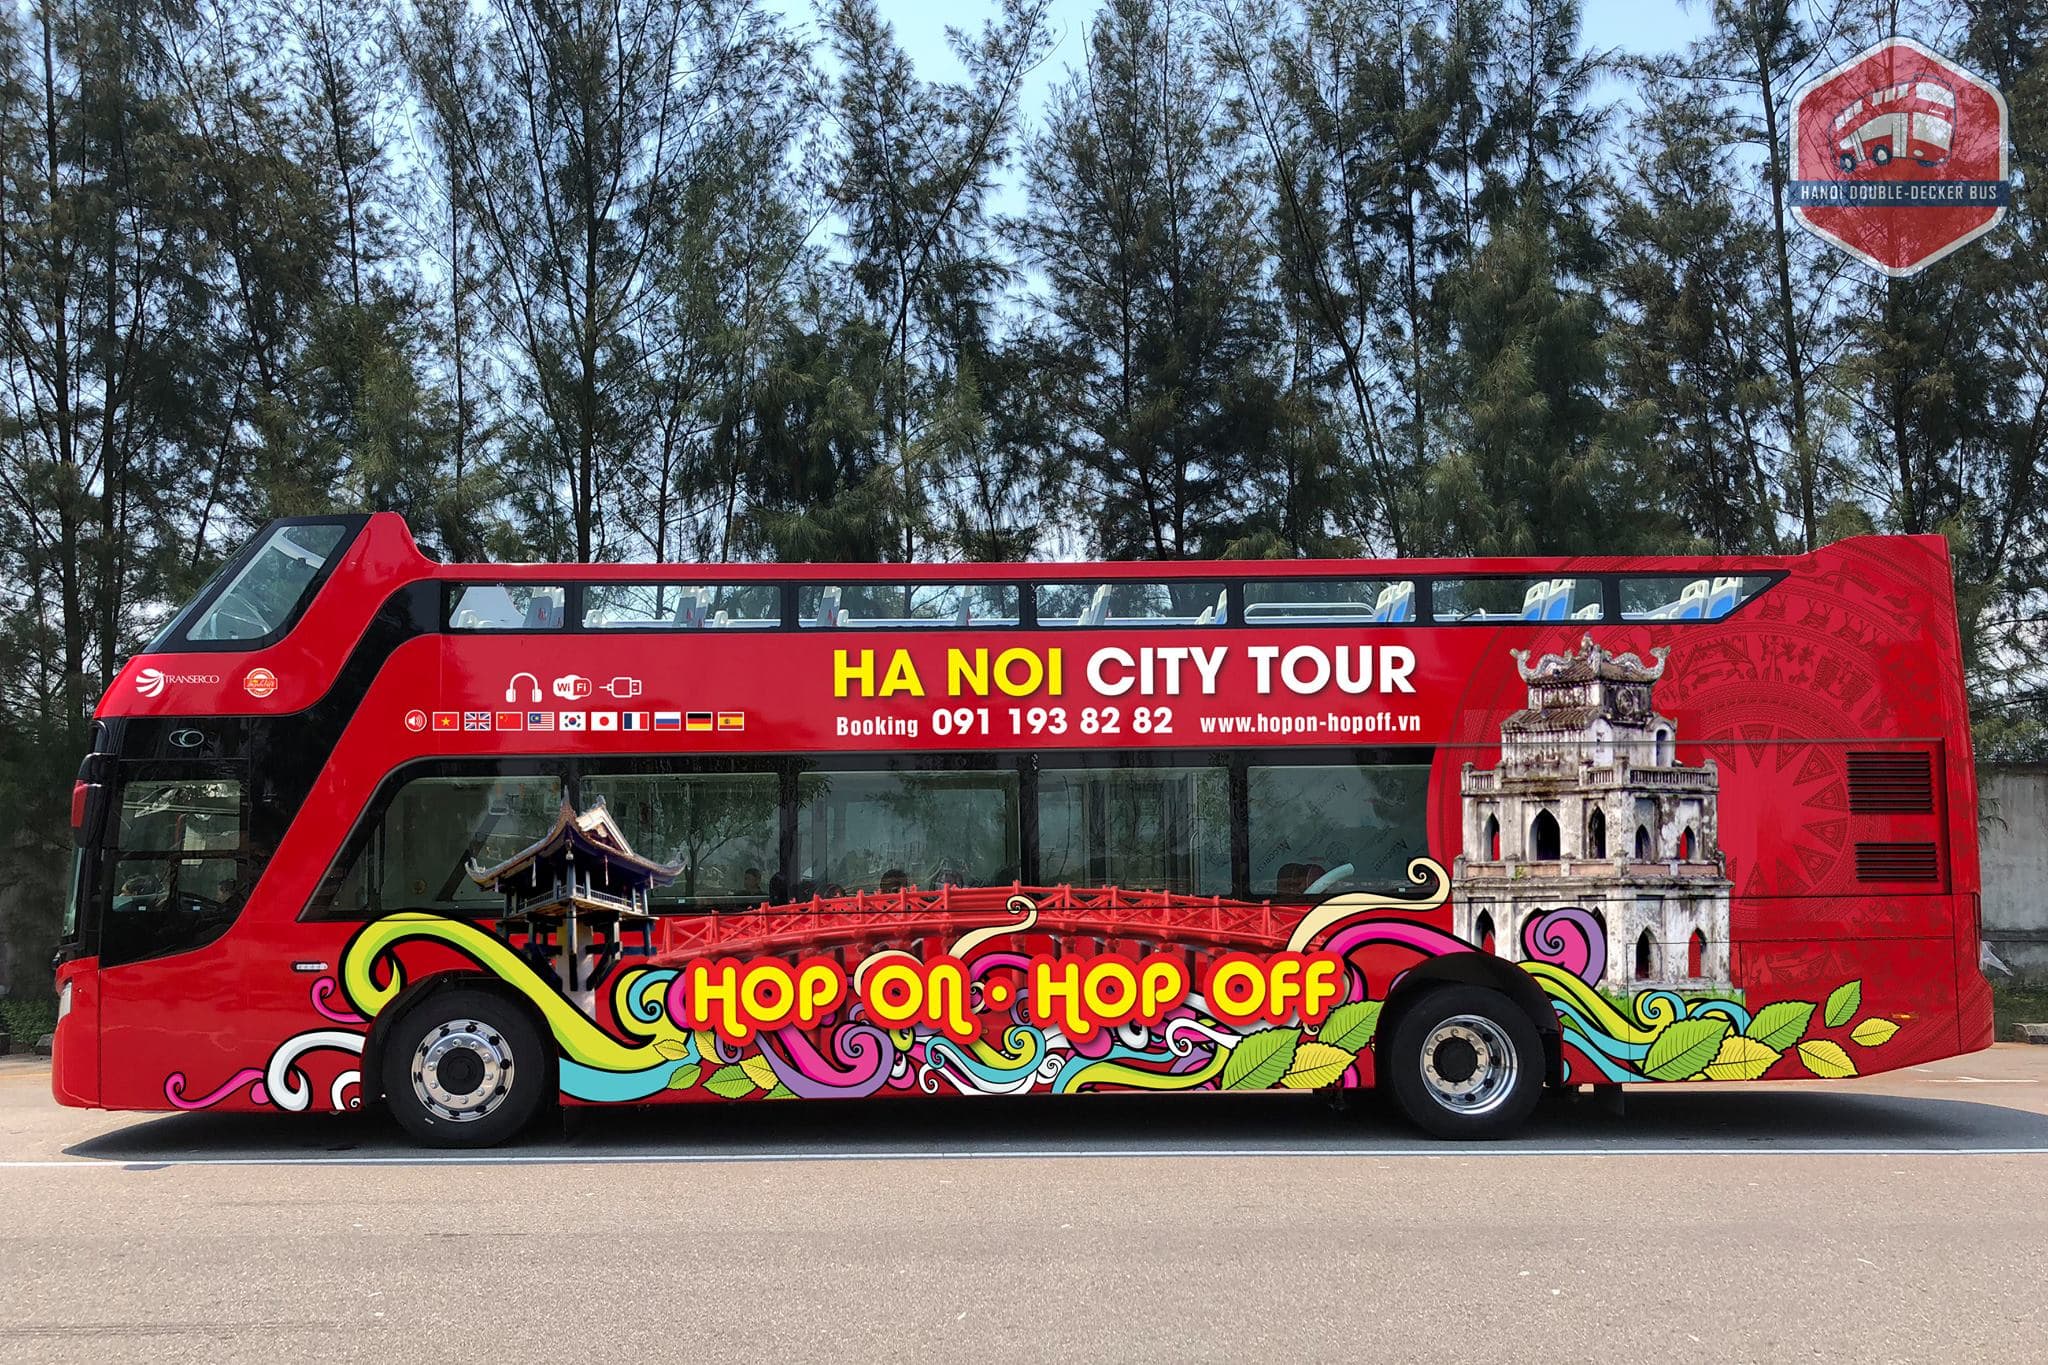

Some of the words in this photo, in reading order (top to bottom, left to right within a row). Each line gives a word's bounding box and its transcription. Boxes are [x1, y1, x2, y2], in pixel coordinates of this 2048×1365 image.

[164, 674, 220, 684] TRANSERCO
[833, 648, 925, 697] HA
[947, 647, 1062, 697] NOI
[1086, 646, 1228, 696] CITY
[1247, 645, 1416, 695] TOUR
[836, 716, 918, 737] Booking
[932, 707, 989, 736] 091
[1008, 707, 1068, 735] 193
[1079, 707, 1120, 735] 82
[1132, 706, 1173, 734] 82
[1200, 712, 1421, 735] www.hopon-hopoff.vn
[693, 965, 839, 1038] HOP
[869, 964, 973, 1036] ON
[1036, 961, 1182, 1034] HOP
[1212, 960, 1336, 1017] OFF
